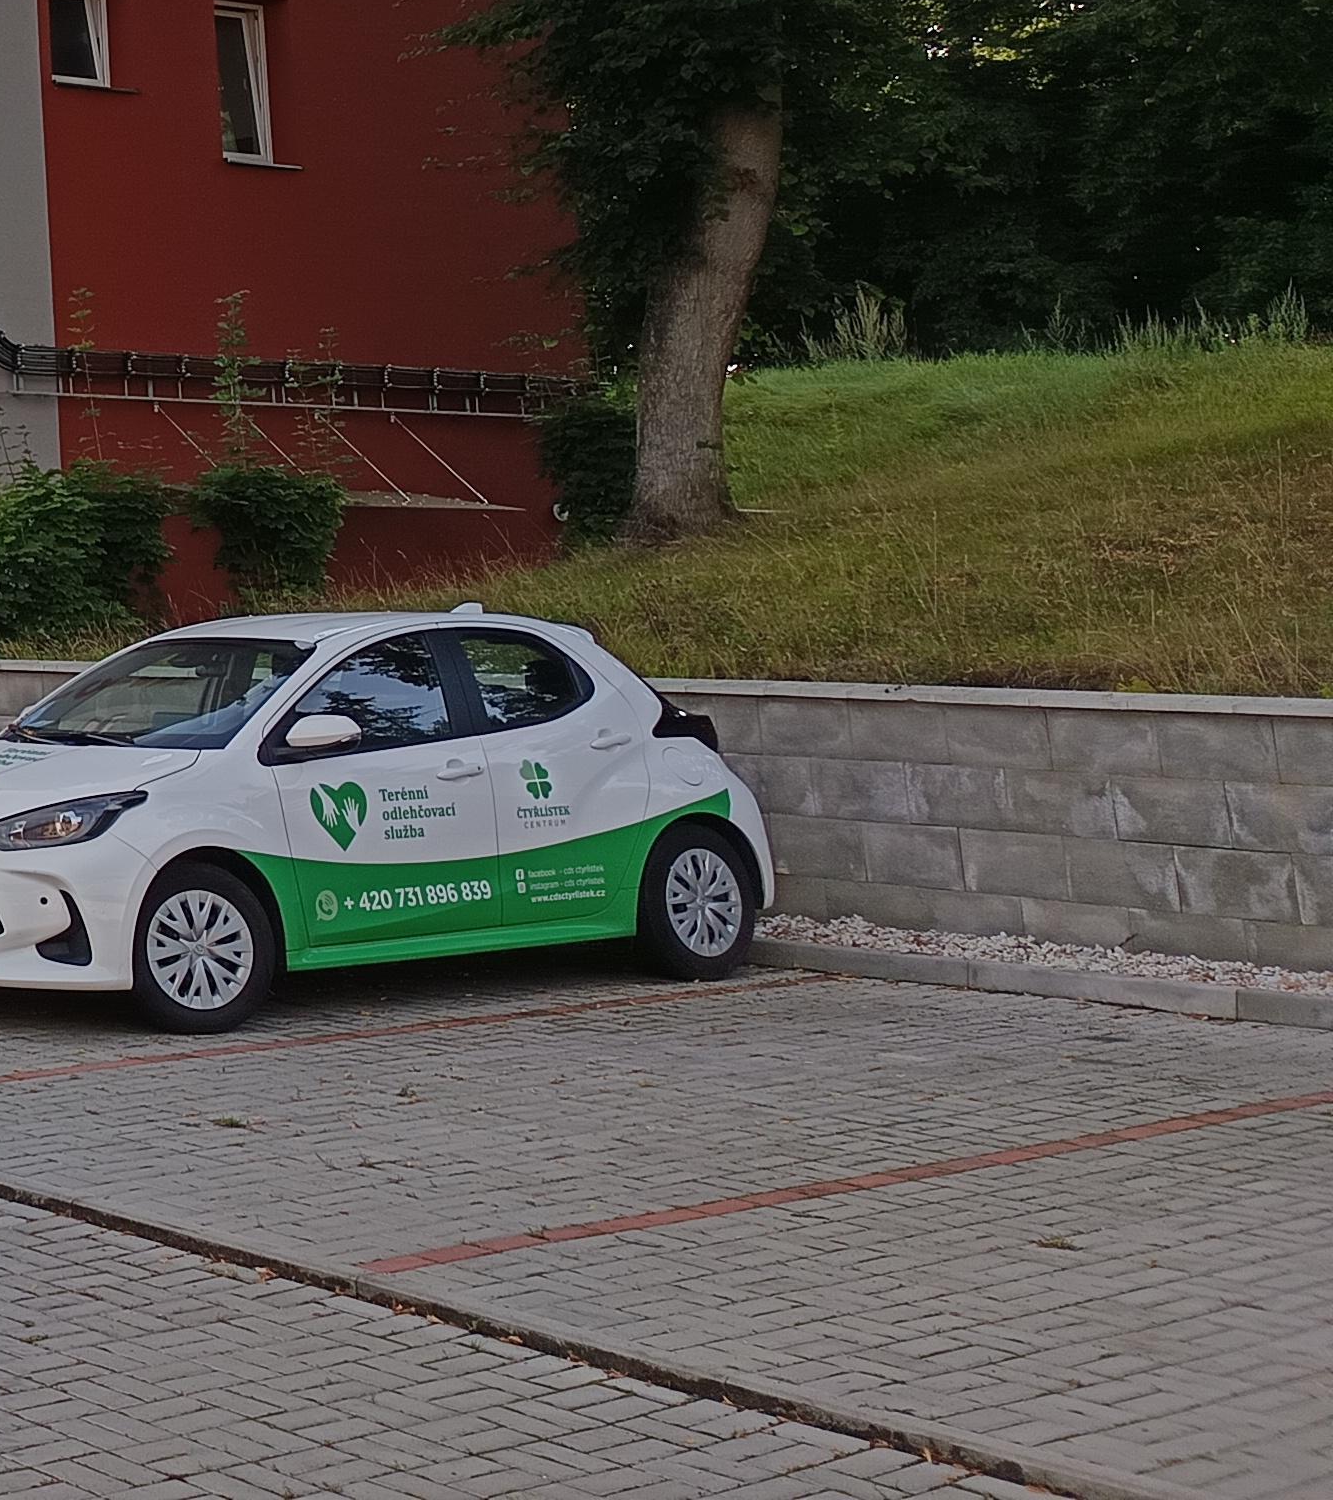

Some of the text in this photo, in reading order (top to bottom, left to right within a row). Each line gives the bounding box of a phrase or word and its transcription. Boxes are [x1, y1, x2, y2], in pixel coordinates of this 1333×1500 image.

[378, 785, 429, 802] Terénní
[382, 802, 456, 821] odlehčovací
[516, 805, 571, 819] ČTYŘLÍSTEK
[384, 824, 425, 840] služba
[524, 819, 566, 829] CENTRUM
[528, 869, 556, 878] facebook
[359, 889, 392, 911] 420
[395, 886, 424, 908] 731
[425, 883, 458, 905] 896
[460, 880, 492, 901] 839
